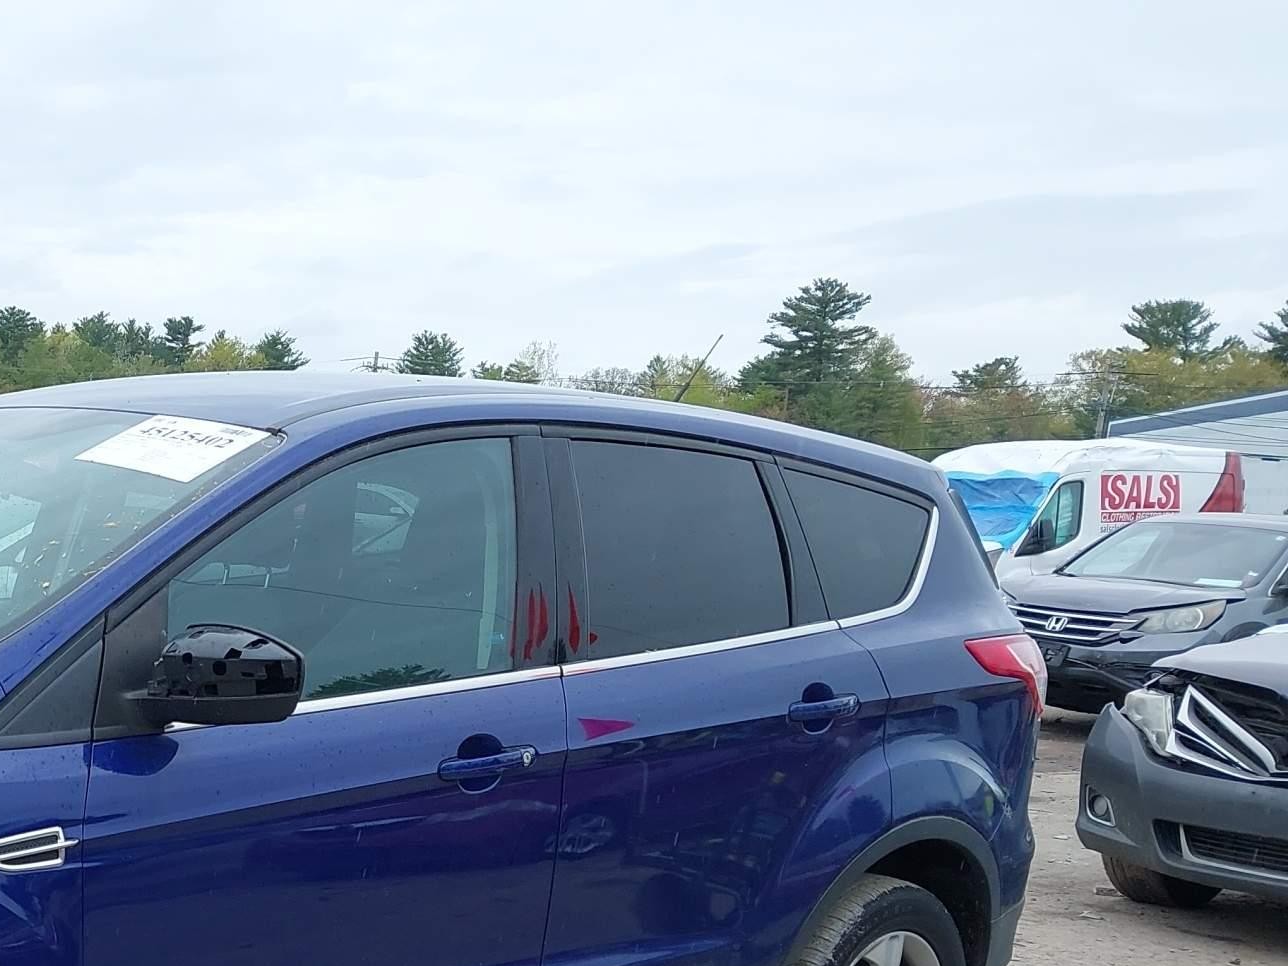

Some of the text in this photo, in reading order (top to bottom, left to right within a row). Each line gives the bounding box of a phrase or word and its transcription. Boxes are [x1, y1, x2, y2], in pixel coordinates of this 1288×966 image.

[139, 427, 235, 449] 45125402
[1104, 473, 1177, 511] SALS
[1101, 512, 1135, 522] CLOTHING
